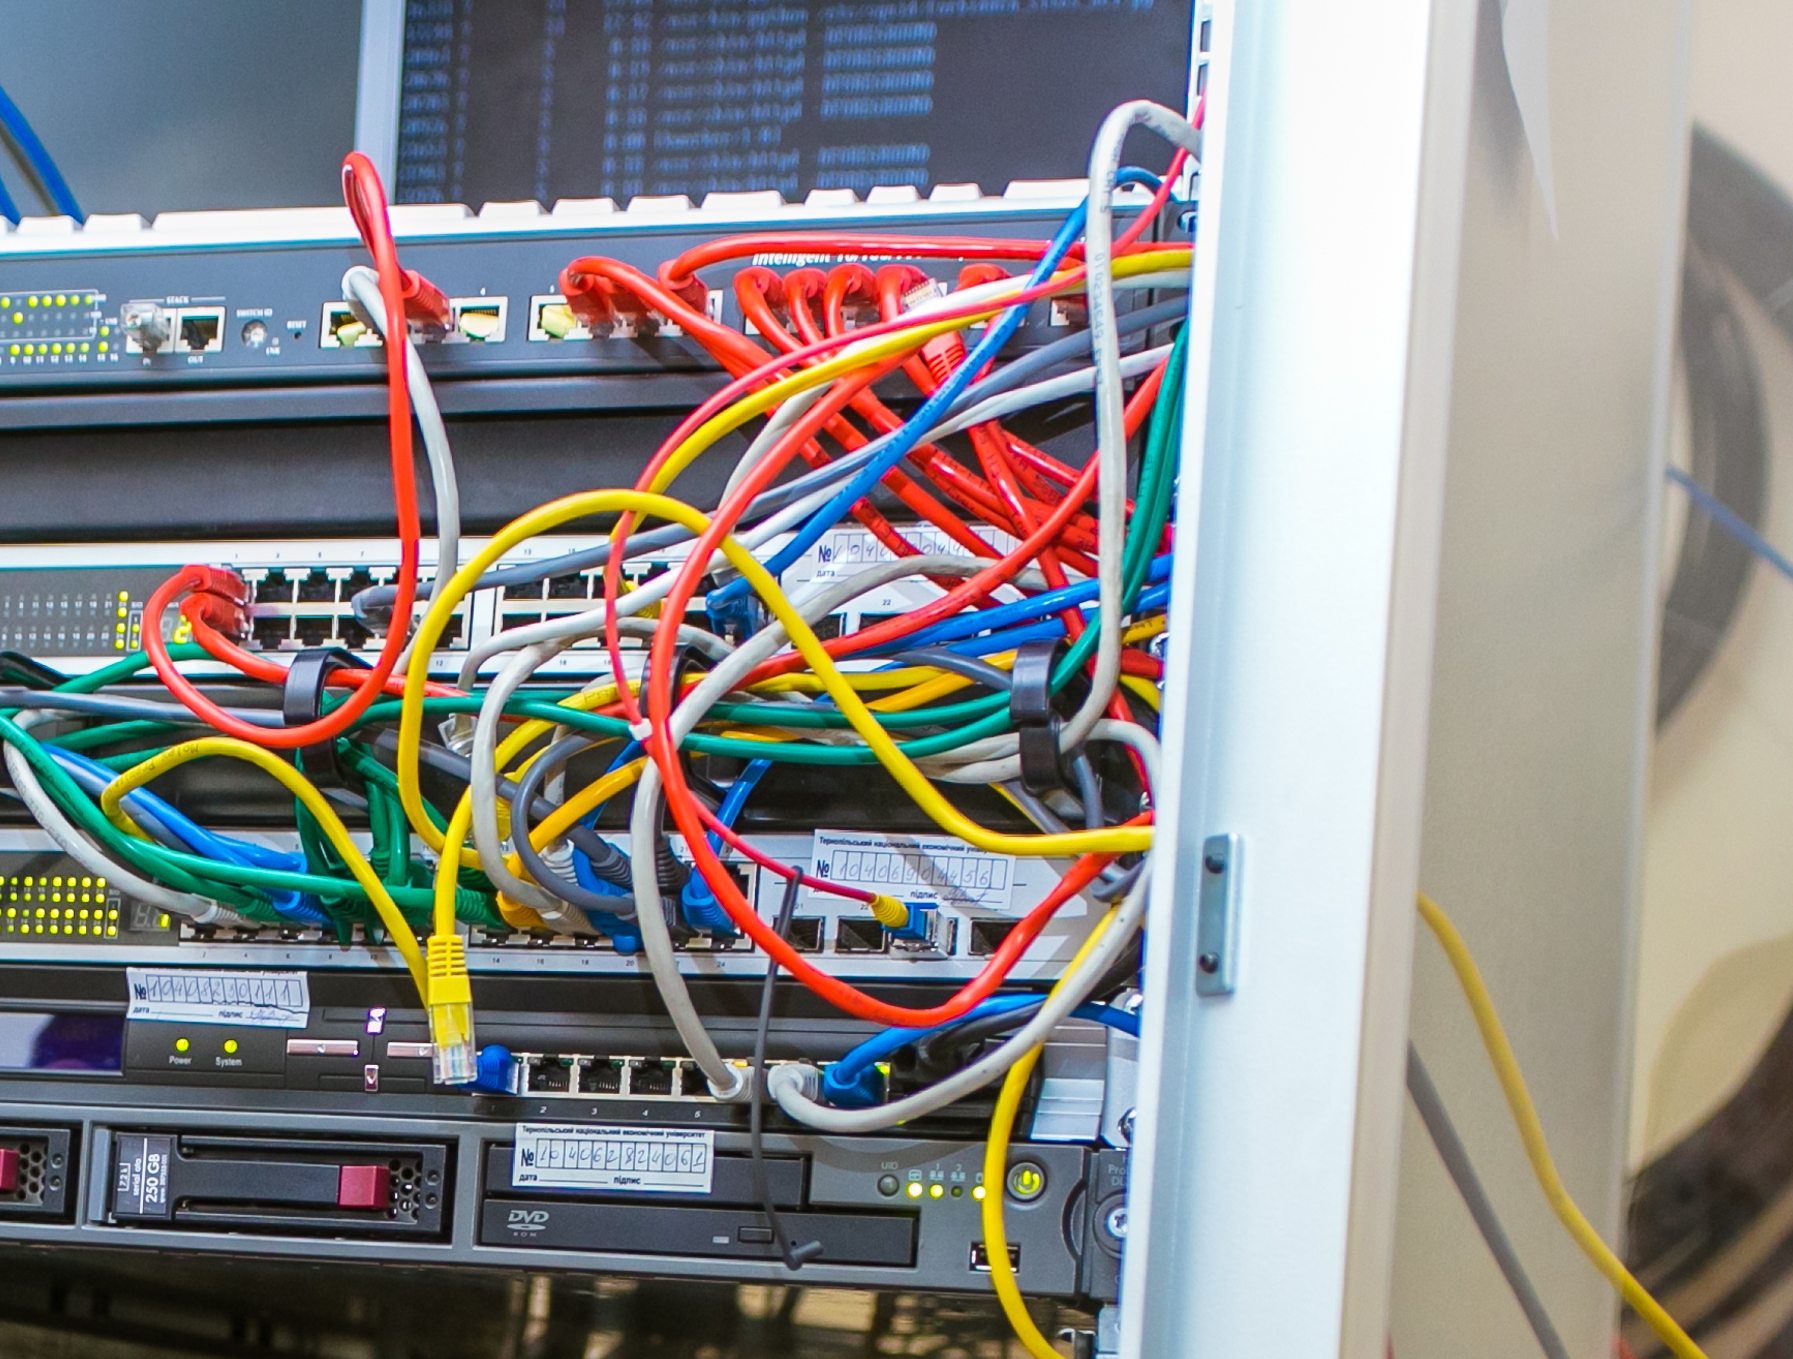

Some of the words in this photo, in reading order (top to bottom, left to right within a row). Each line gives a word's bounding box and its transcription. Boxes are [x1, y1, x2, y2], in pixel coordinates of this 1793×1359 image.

[166, 296, 190, 304] STACK
[236, 308, 263, 318] SWITCH
[286, 320, 307, 330] RESET
[187, 356, 204, 365] OUT
[818, 545, 832, 563] №
[816, 569, 836, 578] дата
[819, 837, 873, 847] Тернопільський
[874, 840, 922, 851] національний
[816, 859, 830, 878] №
[910, 891, 938, 900] підпис
[134, 983, 147, 1001] №
[133, 1006, 150, 1014] дата
[218, 1010, 243, 1019] підпис
[169, 1056, 192, 1066] Power
[215, 1056, 243, 1068] System
[522, 1125, 574, 1134] Тернопільський
[575, 1127, 621, 1136] національний
[623, 1129, 664, 1137] економічний
[666, 1131, 706, 1139] університет
[147, 1153, 161, 1174] GB
[521, 1149, 535, 1167] №
[134, 1158, 142, 1172] ata
[881, 1161, 899, 1170] UID
[519, 1174, 538, 1182] дата
[613, 1176, 641, 1185] підпис
[132, 1173, 140, 1196] serial
[145, 1177, 159, 1203] 250
[508, 1210, 549, 1223] DVD
